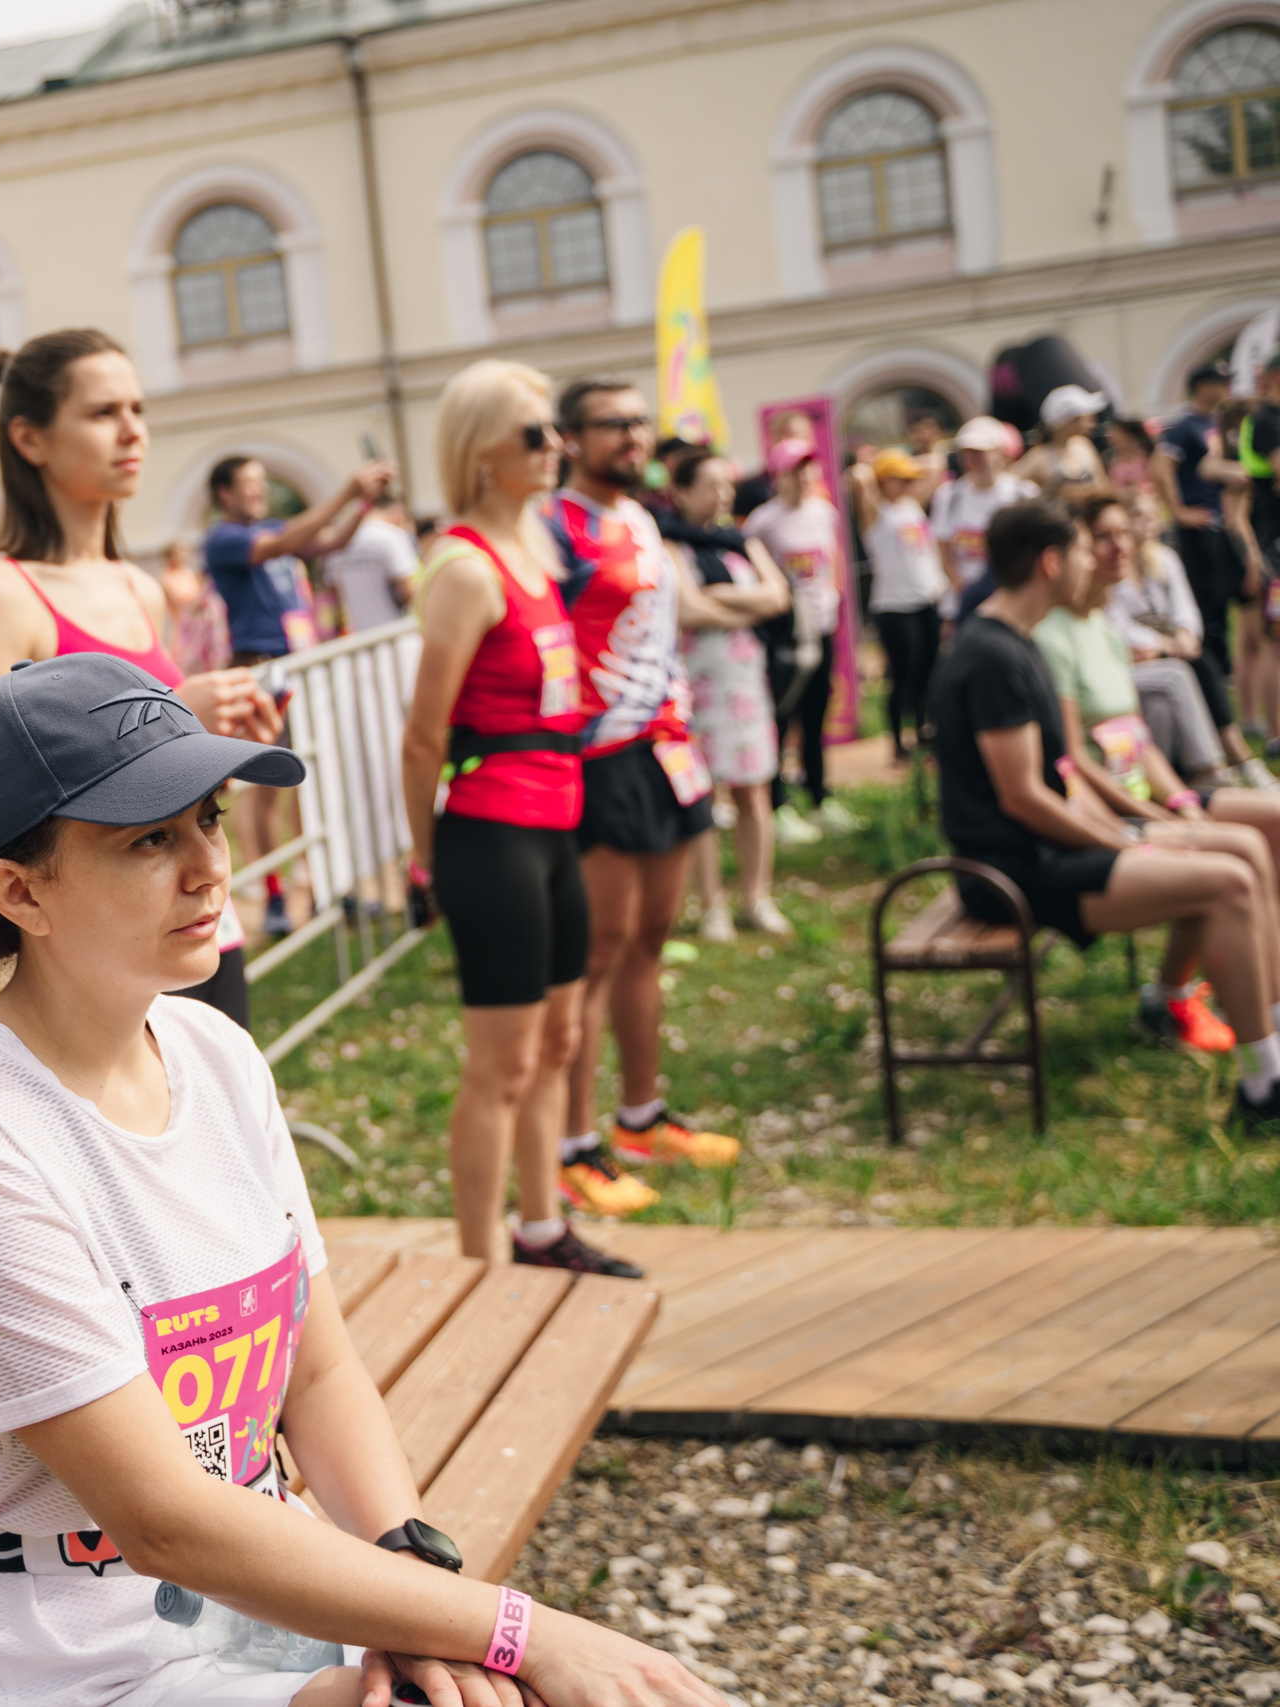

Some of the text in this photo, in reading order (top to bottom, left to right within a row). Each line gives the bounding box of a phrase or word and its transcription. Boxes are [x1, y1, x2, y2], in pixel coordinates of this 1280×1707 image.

[155, 1305, 220, 1337] RUTS
[161, 1326, 234, 1356] КАЗАНЬ 2023
[162, 1314, 282, 1425] 077
